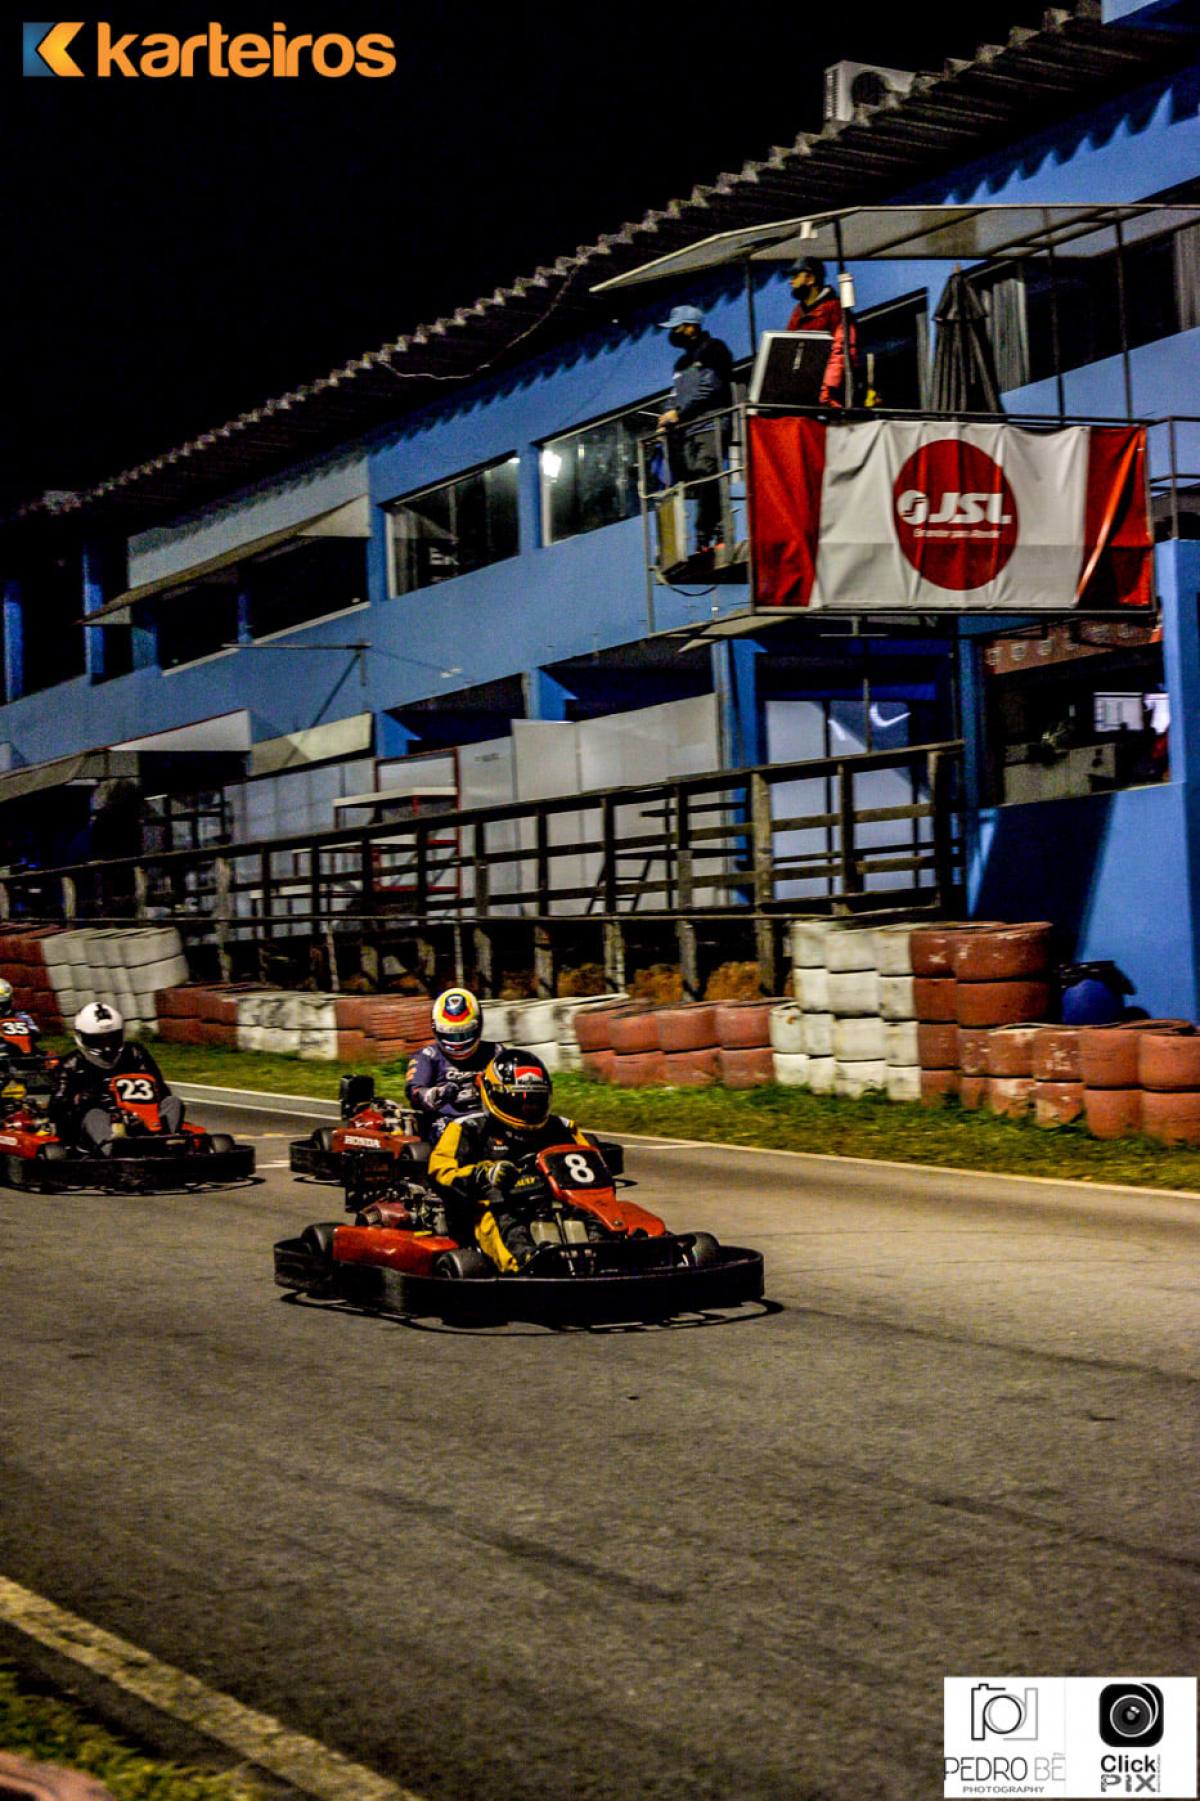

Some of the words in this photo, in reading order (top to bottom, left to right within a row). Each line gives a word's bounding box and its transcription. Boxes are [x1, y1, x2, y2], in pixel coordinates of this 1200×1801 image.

[928, 492, 1012, 525] JSL
[3, 1022, 29, 1034] 35
[116, 1079, 154, 1100] 23
[564, 1153, 595, 1183] 8
